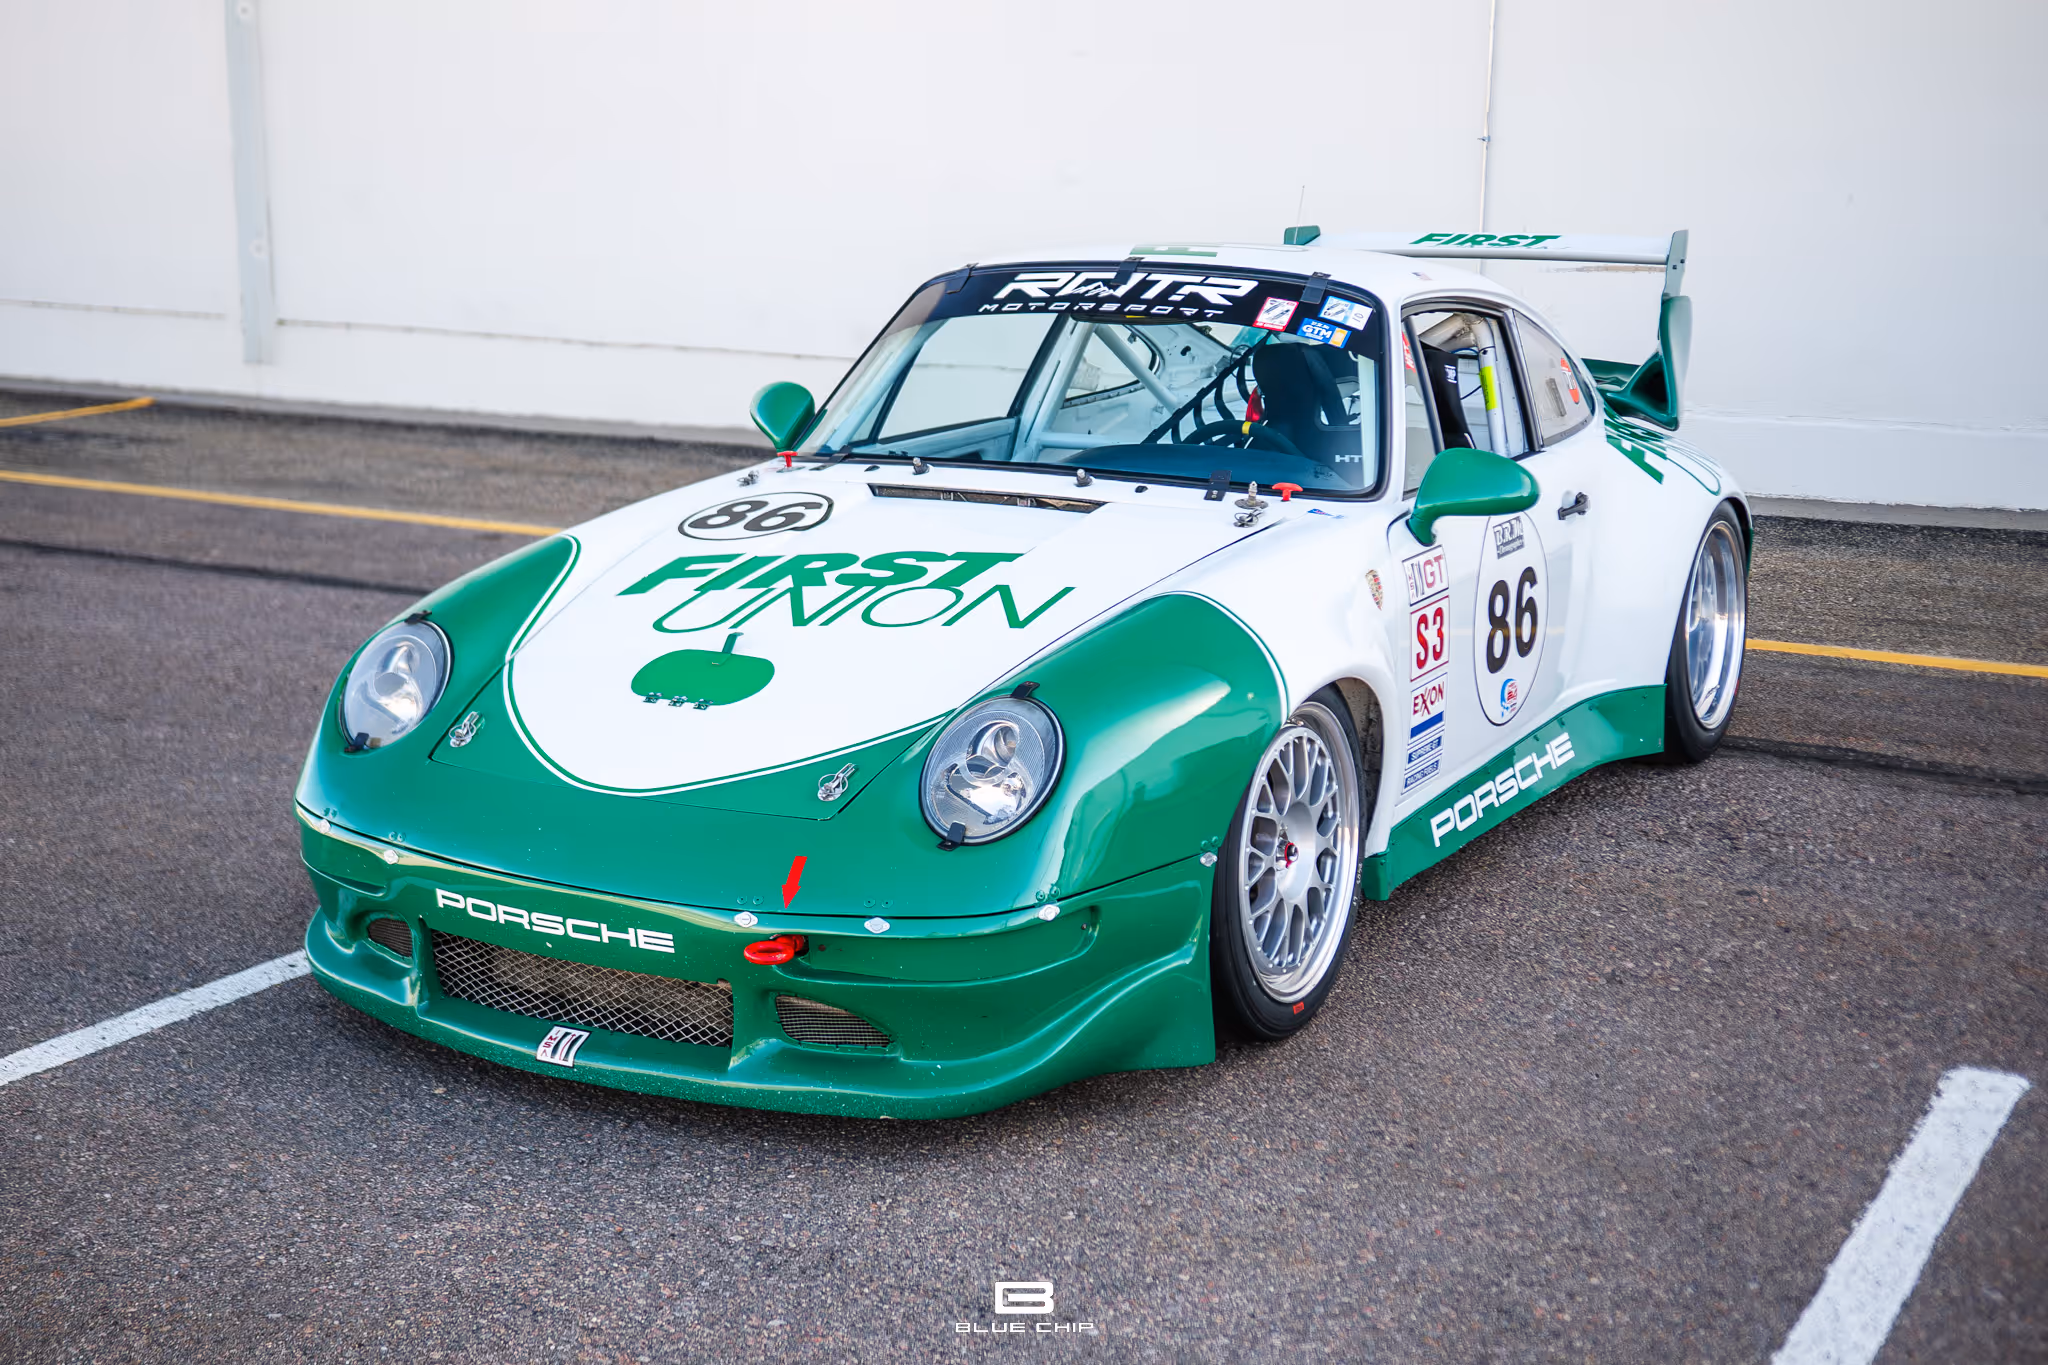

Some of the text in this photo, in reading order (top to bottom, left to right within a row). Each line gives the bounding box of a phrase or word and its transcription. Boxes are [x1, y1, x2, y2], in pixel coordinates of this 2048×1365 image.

[1409, 233, 1563, 247] FIRST
[978, 301, 1225, 319] MOTORSPORT
[1302, 323, 1333, 341] GTM
[687, 500, 824, 532] 86
[615, 551, 1025, 598] FIRST
[1423, 554, 1443, 589] GT
[652, 583, 1078, 634] UNION
[1486, 567, 1538, 674] 86
[1416, 606, 1445, 670] S3
[1412, 681, 1445, 717] EXXON
[1430, 732, 1576, 847] PORSCHE
[436, 888, 675, 953] PORSCHE
